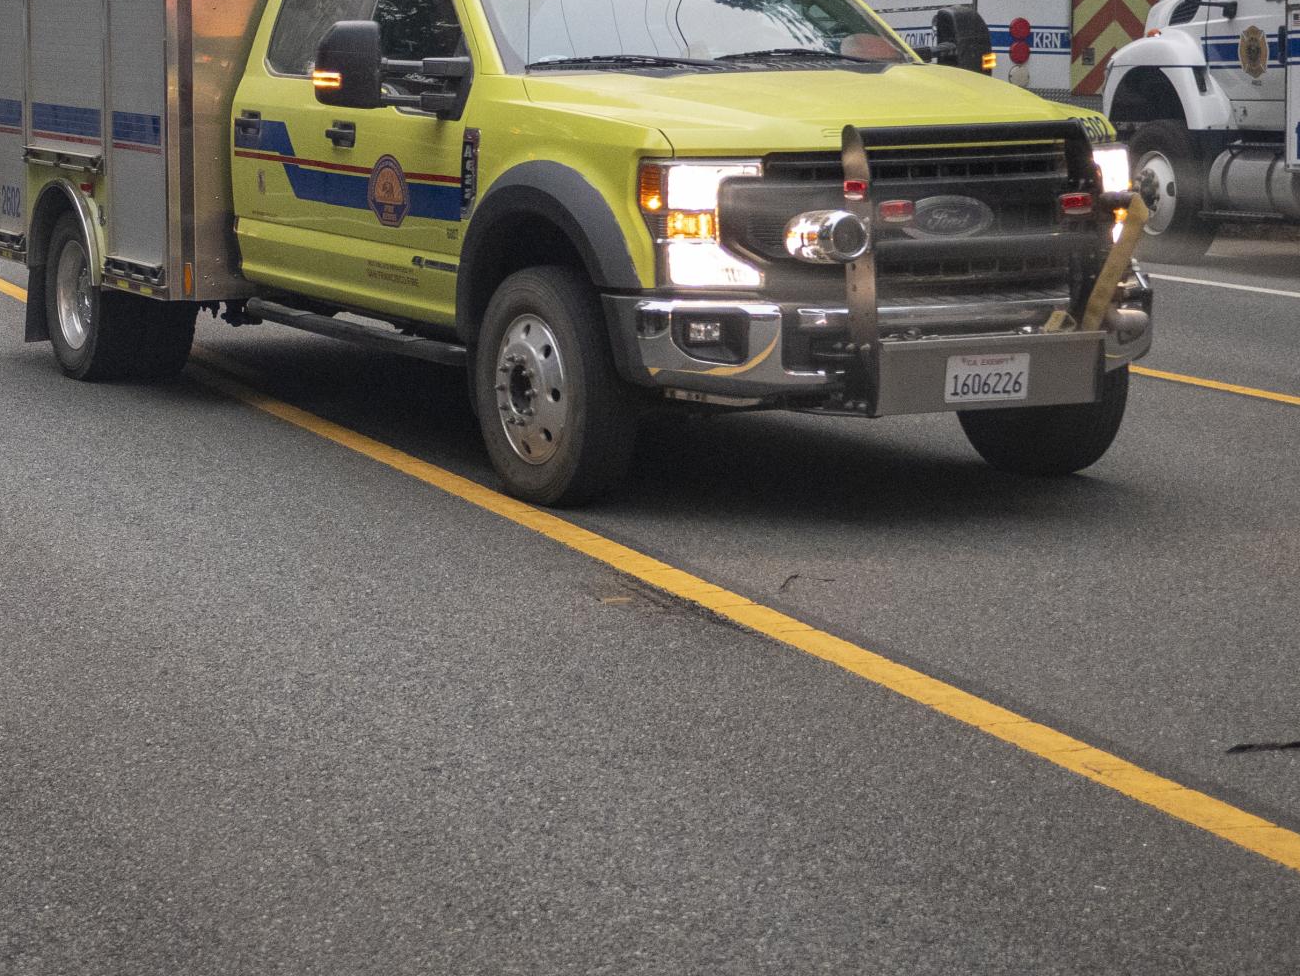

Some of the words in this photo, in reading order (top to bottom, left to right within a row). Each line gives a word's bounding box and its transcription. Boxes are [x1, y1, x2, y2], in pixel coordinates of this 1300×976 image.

[1033, 31, 1061, 49] KRN
[926, 208, 971, 229] Ford
[950, 371, 1024, 397] 1606226
